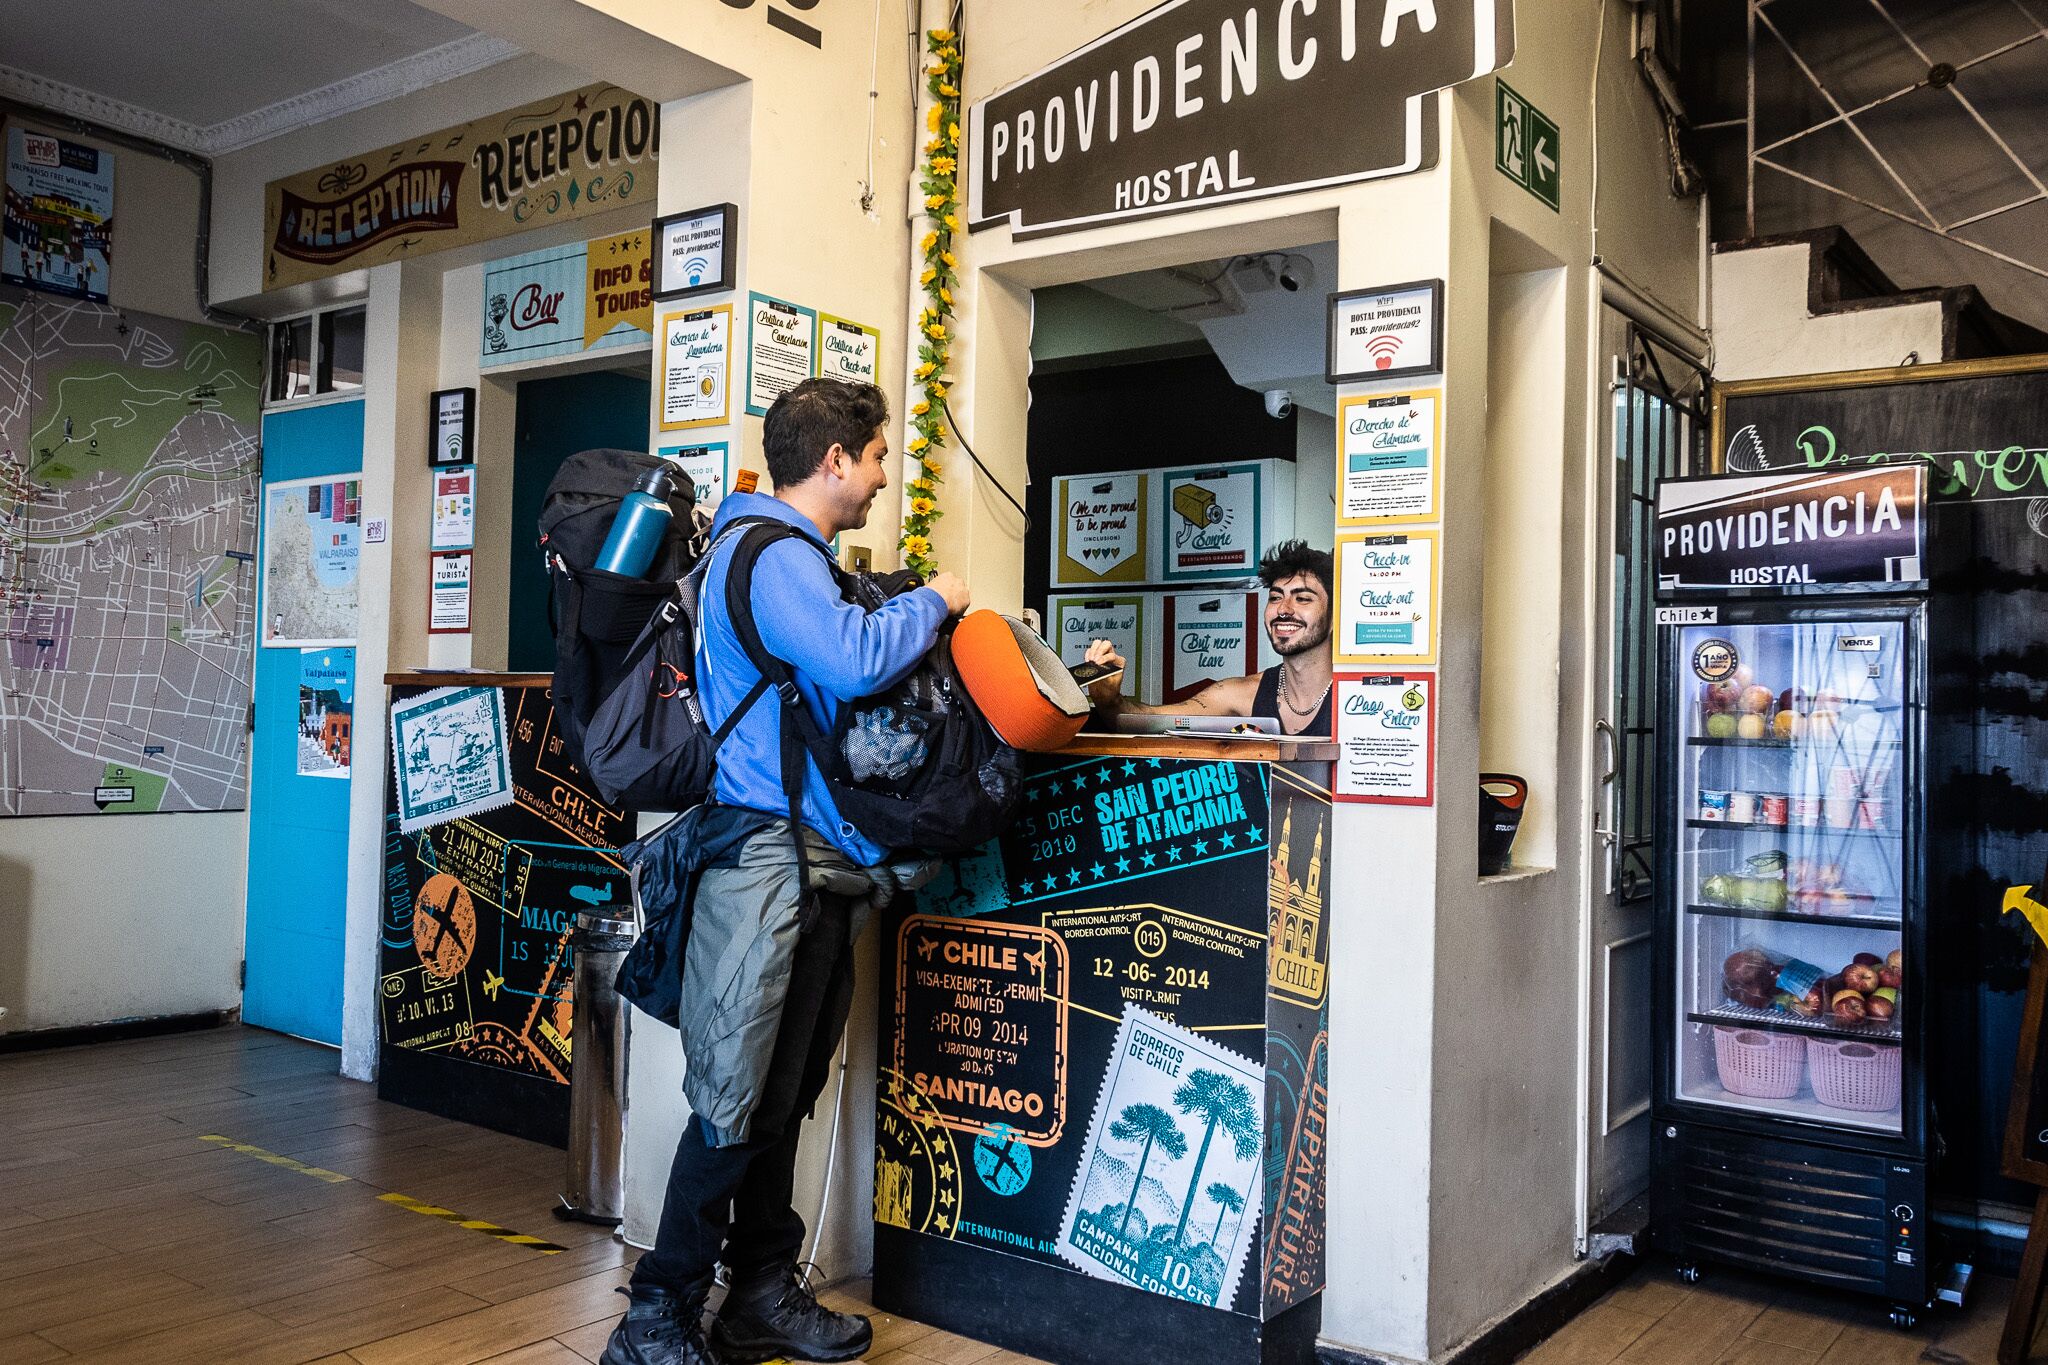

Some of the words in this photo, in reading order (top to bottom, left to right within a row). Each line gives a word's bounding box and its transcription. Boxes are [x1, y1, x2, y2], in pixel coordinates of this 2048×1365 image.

[991, 0, 1437, 182] PROVIDENCIA
[1115, 150, 1256, 210] HOSTAL
[300, 167, 444, 248] RECEPTION
[593, 263, 632, 291] INFO
[510, 283, 565, 331] Bar
[595, 287, 651, 318] TOURS
[1351, 312, 1375, 323] HOSTAL
[1377, 305, 1421, 319] PROVIDENCIA
[1376, 297, 1394, 306] WIFI
[1350, 326, 1368, 336] PASS:
[1350, 416, 1395, 436] Derecho
[1398, 416, 1409, 428] de
[1070, 501, 1094, 518] We
[1092, 503, 1109, 514] are
[1110, 498, 1137, 516] proud
[1664, 486, 1902, 558] PROVIDENCIA
[1076, 519, 1084, 531] to
[1088, 518, 1099, 531] be
[1100, 516, 1127, 533] proud
[446, 562, 458, 570] IVA
[1364, 551, 1411, 569] Check-in
[1730, 564, 1817, 584] HOSTAL
[437, 569, 467, 580] TURISTA
[1360, 590, 1415, 608] Check-out
[1065, 616, 1086, 633] Did
[1088, 620, 1103, 633] you
[1104, 617, 1119, 630] like
[1660, 609, 1698, 622] Chile
[1181, 633, 1210, 653] But
[1212, 636, 1241, 650] never
[1842, 639, 1874, 647] VENTUS
[1198, 653, 1225, 669] leave
[478, 693, 491, 710] 30
[1345, 694, 1384, 715] Pago
[517, 717, 535, 744] 456
[1381, 709, 1420, 730] Entero
[513, 782, 575, 831] NTERNACIONAL
[1094, 781, 1149, 825] SAN
[1152, 760, 1239, 810] PEDRO
[552, 786, 608, 835] CHILE
[1048, 805, 1083, 831] DEC
[1101, 823, 1131, 853] DE
[1136, 792, 1248, 846] ATACAMA
[441, 825, 455, 846] 21
[457, 834, 478, 859] JAN
[479, 846, 505, 875] 2013
[1031, 834, 1076, 862] 2010
[447, 847, 494, 880] ENTRADA
[551, 857, 578, 871] General
[578, 861, 587, 872] de
[514, 865, 527, 895] 345
[390, 889, 413, 923] 2012
[1051, 913, 1108, 927] INTERNATIONAL
[1064, 927, 1095, 939] BORDER
[1095, 925, 1131, 937] CONTROL
[1140, 930, 1160, 947] 015
[1161, 913, 1224, 942] INTERNATIONAL
[943, 940, 1018, 972] CHILE
[1172, 929, 1205, 947] BORDER
[1205, 938, 1245, 959] CONTROL
[916, 970, 1001, 996] VISA-EXEMPTE
[1003, 981, 1047, 1003] PERMIT
[1093, 957, 1114, 978] 12
[1121, 961, 1157, 982] -06-
[1164, 965, 1210, 990] 2014
[1276, 957, 1319, 991] CHILE
[442, 992, 454, 1011] 13
[1120, 986, 1144, 1001] VISIT
[455, 1020, 470, 1038] 08
[930, 1010, 960, 1036] APR
[963, 1016, 982, 1039] 09
[991, 1020, 1028, 1047] 2014
[534, 1032, 564, 1067] EASTER
[551, 1033, 571, 1058] Rapa
[1132, 1028, 1185, 1064] CORREOS
[1128, 1041, 1146, 1061] DE
[1146, 1048, 1181, 1079] CHILE
[913, 1072, 1044, 1118] SANTIAGO
[1269, 1081, 1328, 1304] DEPARTURE
[957, 1219, 1035, 1250] NTERNATIONAL
[1079, 1218, 1140, 1264] CAMPAÑA
[1075, 1233, 1138, 1282] NACIONAL
[1160, 1254, 1191, 1291] 10
[1187, 1284, 1212, 1307] CTS
